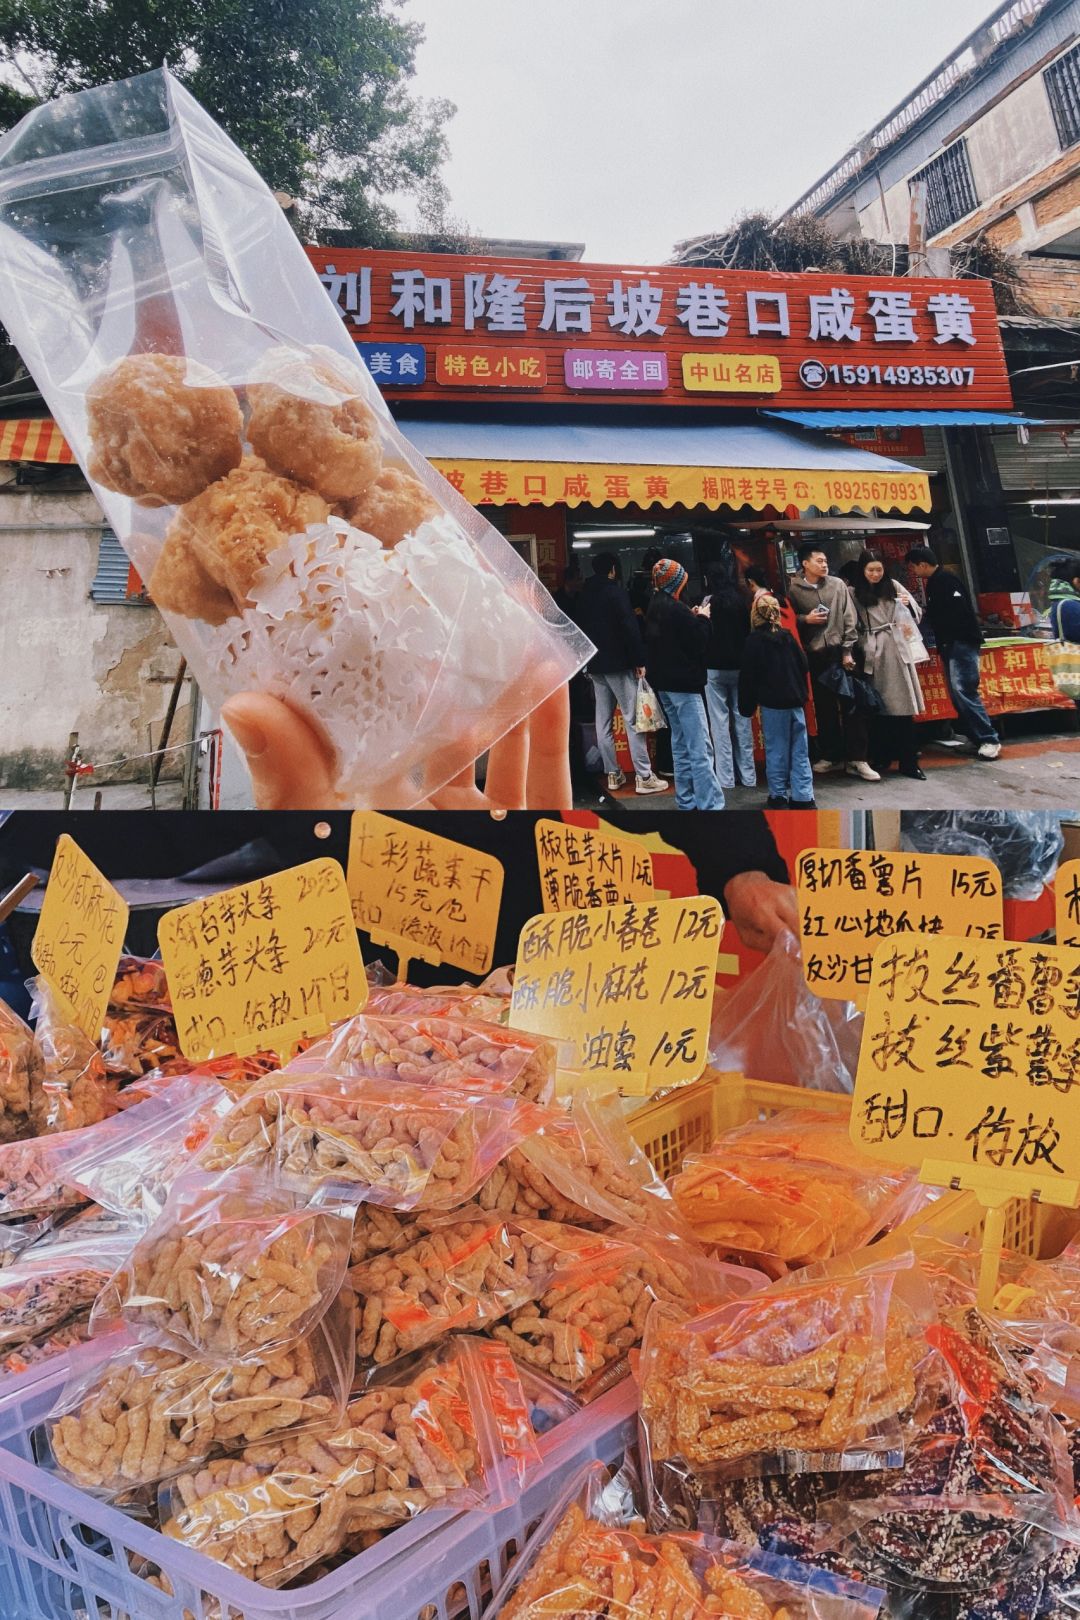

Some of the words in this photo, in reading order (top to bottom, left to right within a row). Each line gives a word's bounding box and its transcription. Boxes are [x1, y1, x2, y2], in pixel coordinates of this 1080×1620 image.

[318, 264, 978, 347] 刘和隆后坡巷口咸蛋黄
[364, 352, 419, 376] 美食
[444, 354, 541, 378] 特色小吃
[572, 358, 662, 382] 邮寄全国
[689, 361, 775, 384] 中山名店
[829, 365, 975, 388] 15914935307
[702, 476, 788, 500] 揭阳老字号
[824, 481, 926, 500] 18925679931
[539, 826, 624, 882] 椒盐芋头片
[297, 865, 341, 903] 20元
[798, 851, 922, 899] 厚切番薯片
[951, 868, 997, 899] 15元
[303, 914, 347, 955] 20元
[522, 905, 661, 964] 酥脆小春卷
[672, 906, 720, 944] 12元
[512, 957, 649, 1014] 酥脆小麻花
[660, 965, 710, 1004] 12元
[650, 1027, 697, 1068] 10元
